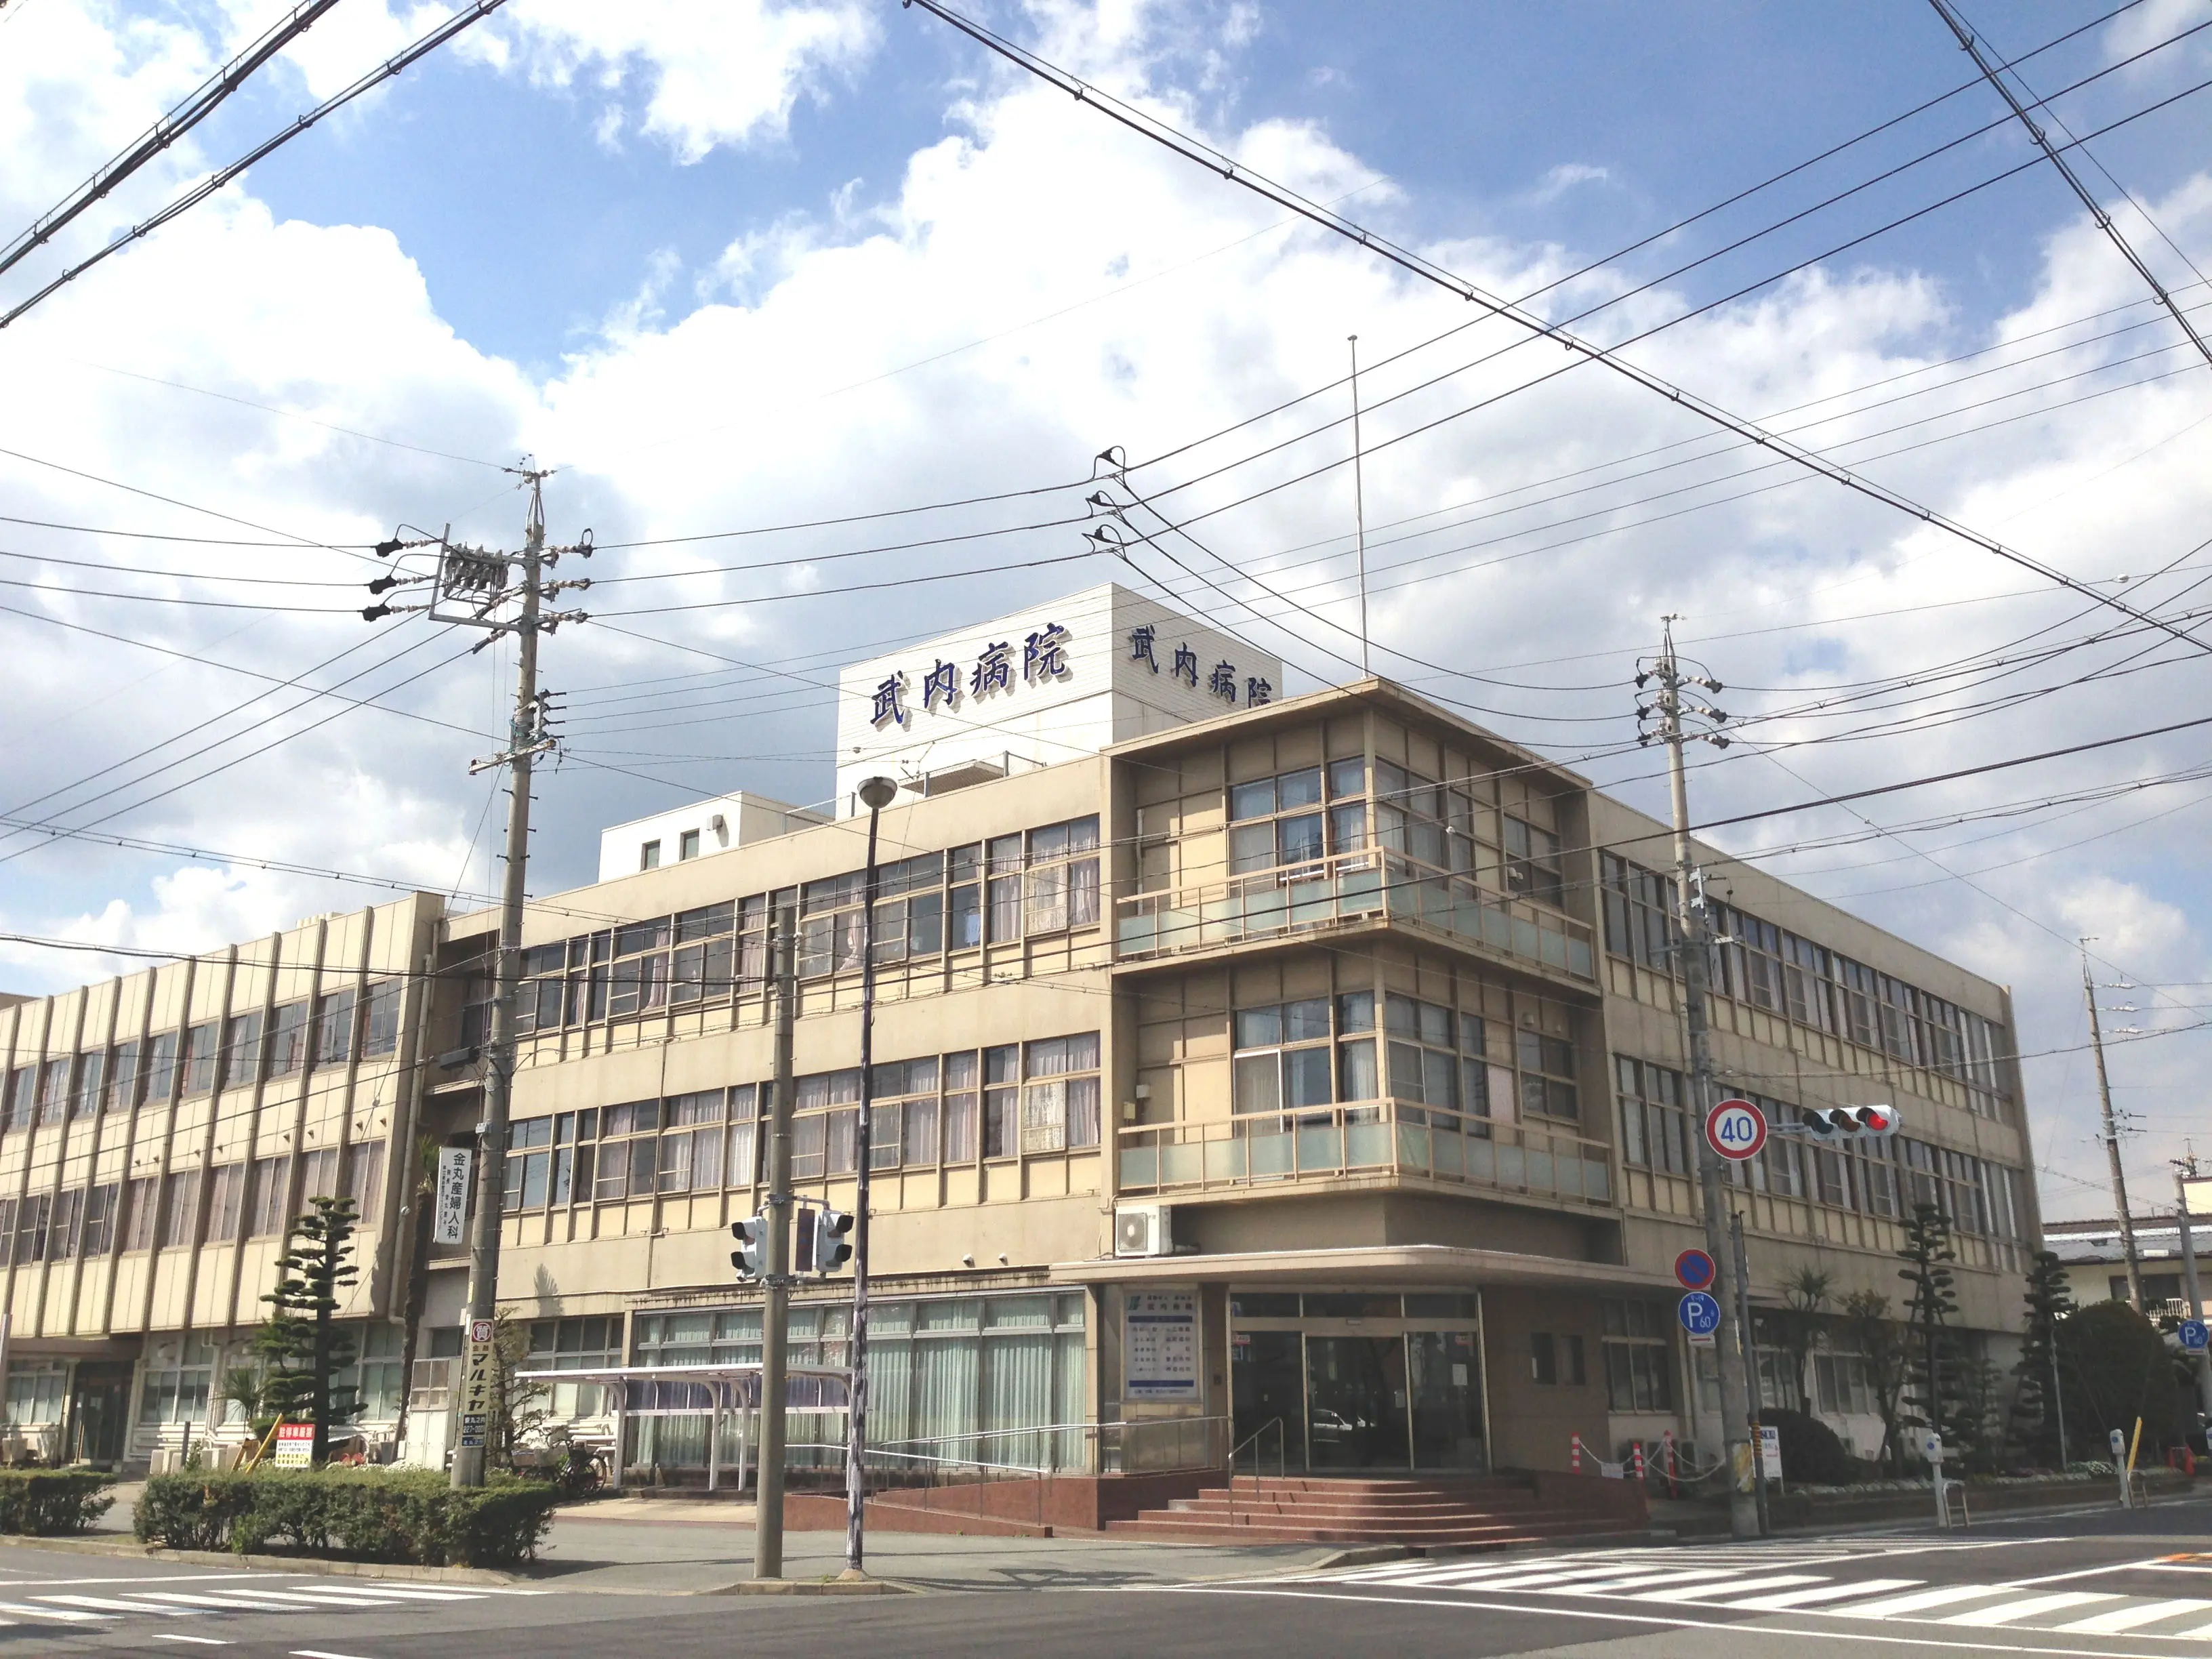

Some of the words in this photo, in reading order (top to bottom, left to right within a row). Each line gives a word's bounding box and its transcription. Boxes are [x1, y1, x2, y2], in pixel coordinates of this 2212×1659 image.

[870, 622, 1065, 724] 武内病院
[1132, 625, 1272, 709] 武内病院
[1721, 1116, 1753, 1143] 40
[447, 1152, 466, 1239] 金丸産婦人科
[1687, 1302, 1703, 1328] P
[1700, 1316, 1711, 1328] 60
[2184, 1327, 2196, 1345] P
